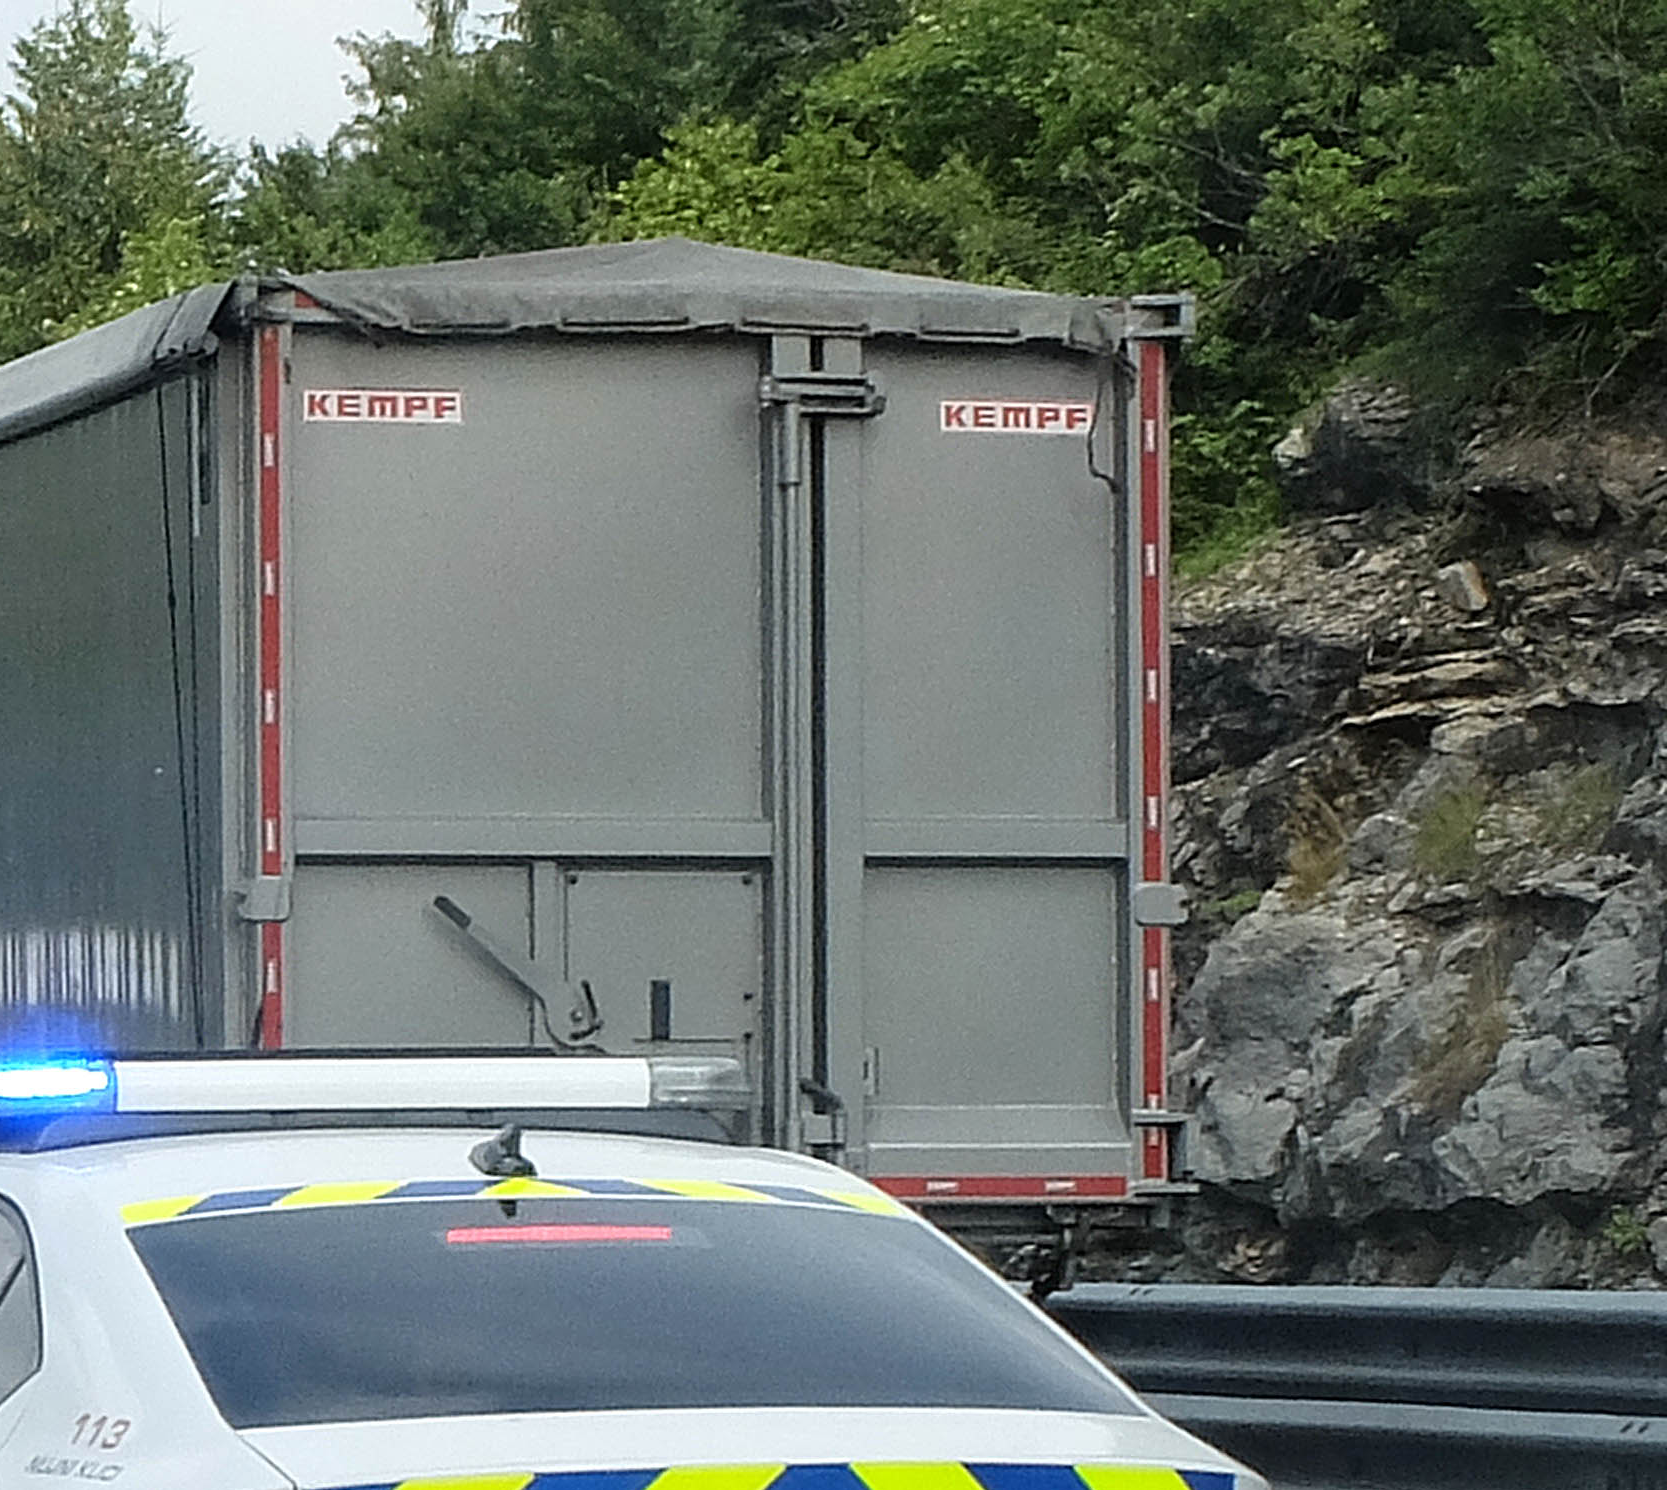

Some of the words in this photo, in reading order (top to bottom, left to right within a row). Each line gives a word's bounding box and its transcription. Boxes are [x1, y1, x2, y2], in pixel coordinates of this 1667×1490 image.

[307, 394, 456, 418] KEMPF
[944, 405, 1087, 430] KEMPF
[71, 1413, 131, 1449] 113
